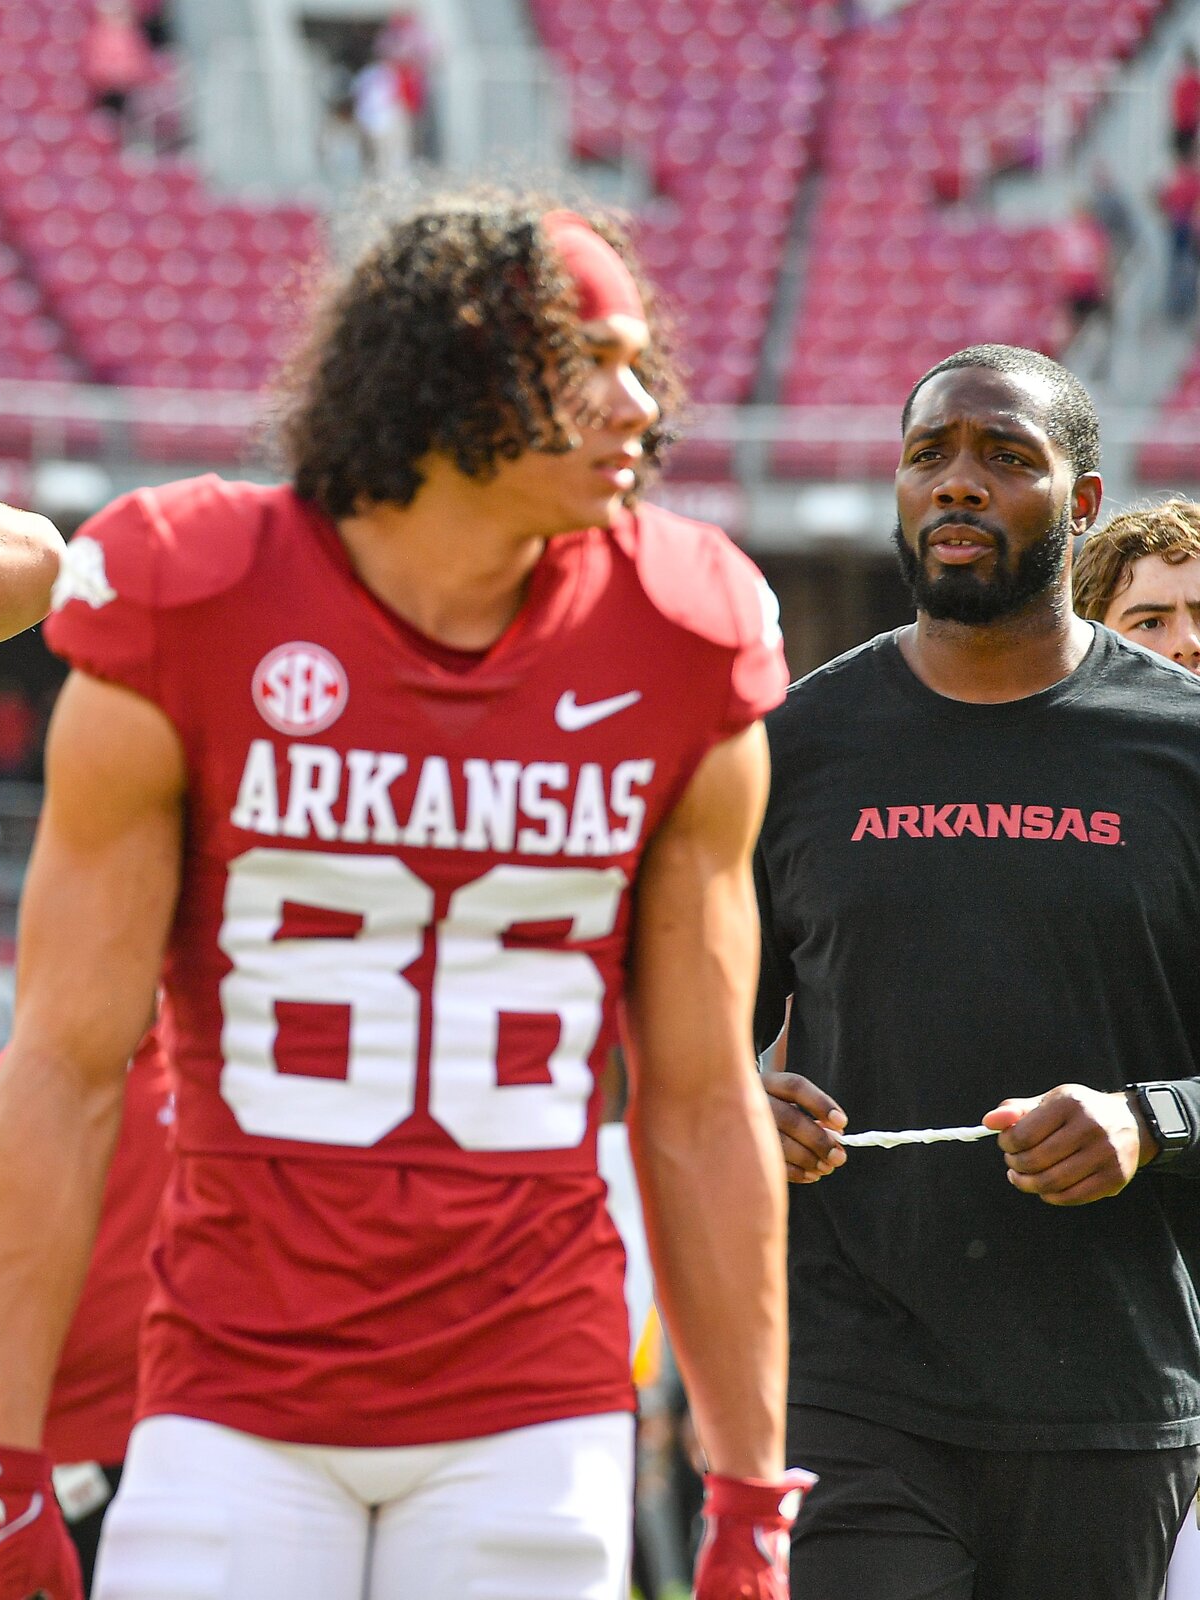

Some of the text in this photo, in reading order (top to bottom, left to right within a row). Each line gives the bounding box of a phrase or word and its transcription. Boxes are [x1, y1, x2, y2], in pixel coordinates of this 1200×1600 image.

[264, 653, 337, 724] SEC
[230, 738, 655, 856] ARKANSAS
[851, 803, 1121, 845] ARKANSAS
[218, 847, 627, 1152] 86
